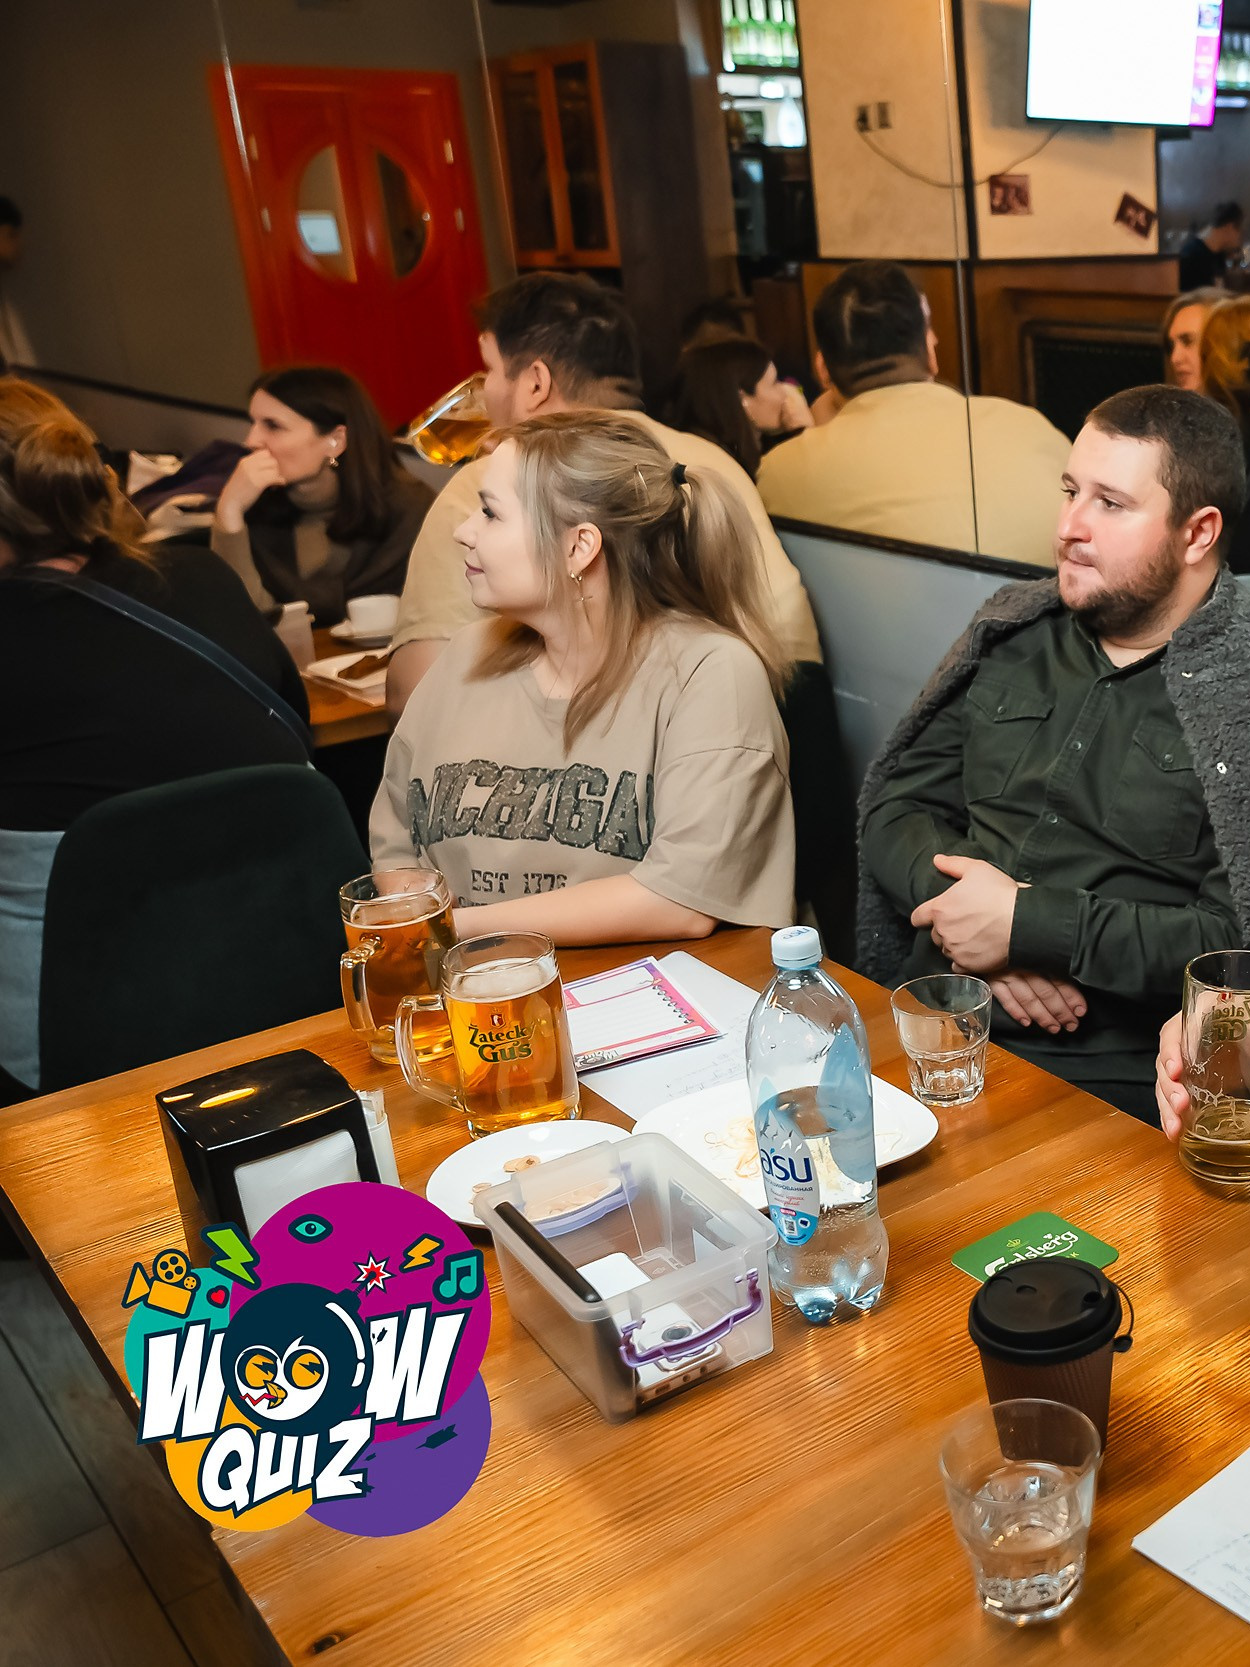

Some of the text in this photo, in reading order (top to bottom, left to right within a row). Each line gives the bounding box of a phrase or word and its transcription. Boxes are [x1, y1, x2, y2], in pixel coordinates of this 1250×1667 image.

[406, 758, 656, 862] ICHIGA
[471, 869, 509, 894] EST
[984, 1231, 1080, 1277] Clsberg
